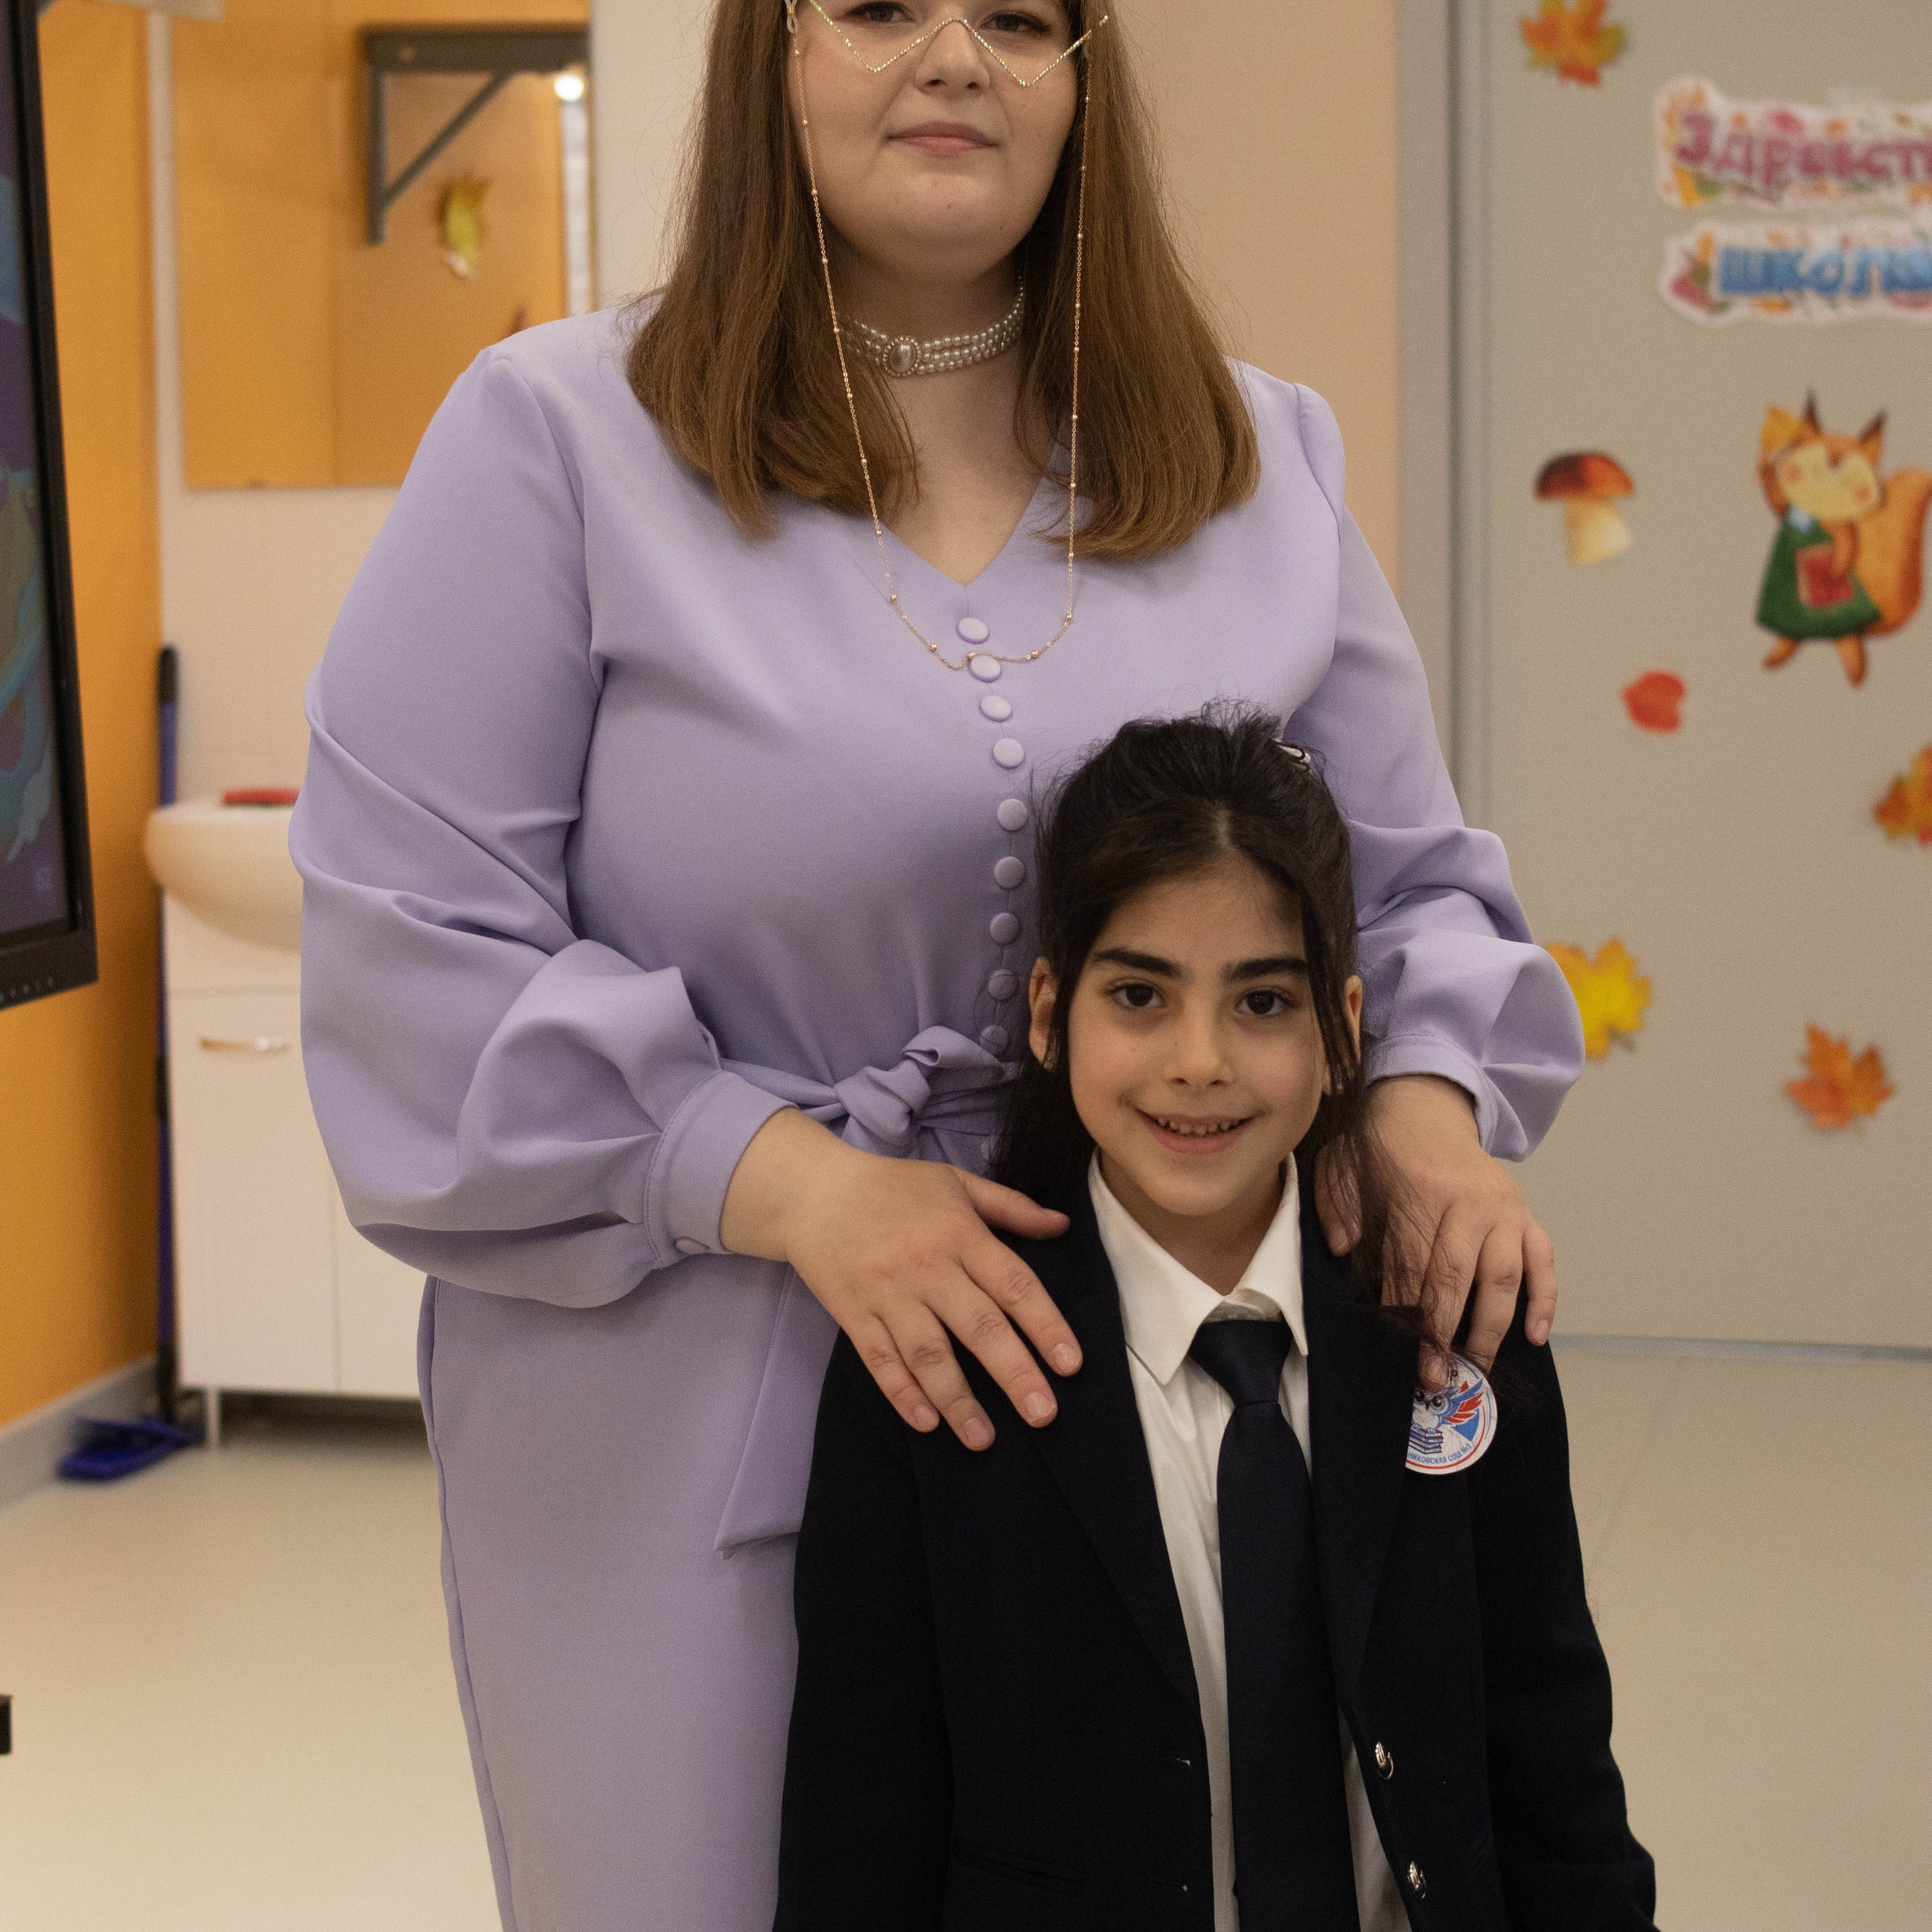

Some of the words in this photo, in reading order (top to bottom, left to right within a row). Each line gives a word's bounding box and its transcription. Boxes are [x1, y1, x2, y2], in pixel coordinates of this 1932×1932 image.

[1675, 110, 1932, 185] ЗДРАВСТ
[1407, 1452, 1447, 1463] НИКОВСКАЯ
[1448, 1451, 1462, 1461] СОШ
